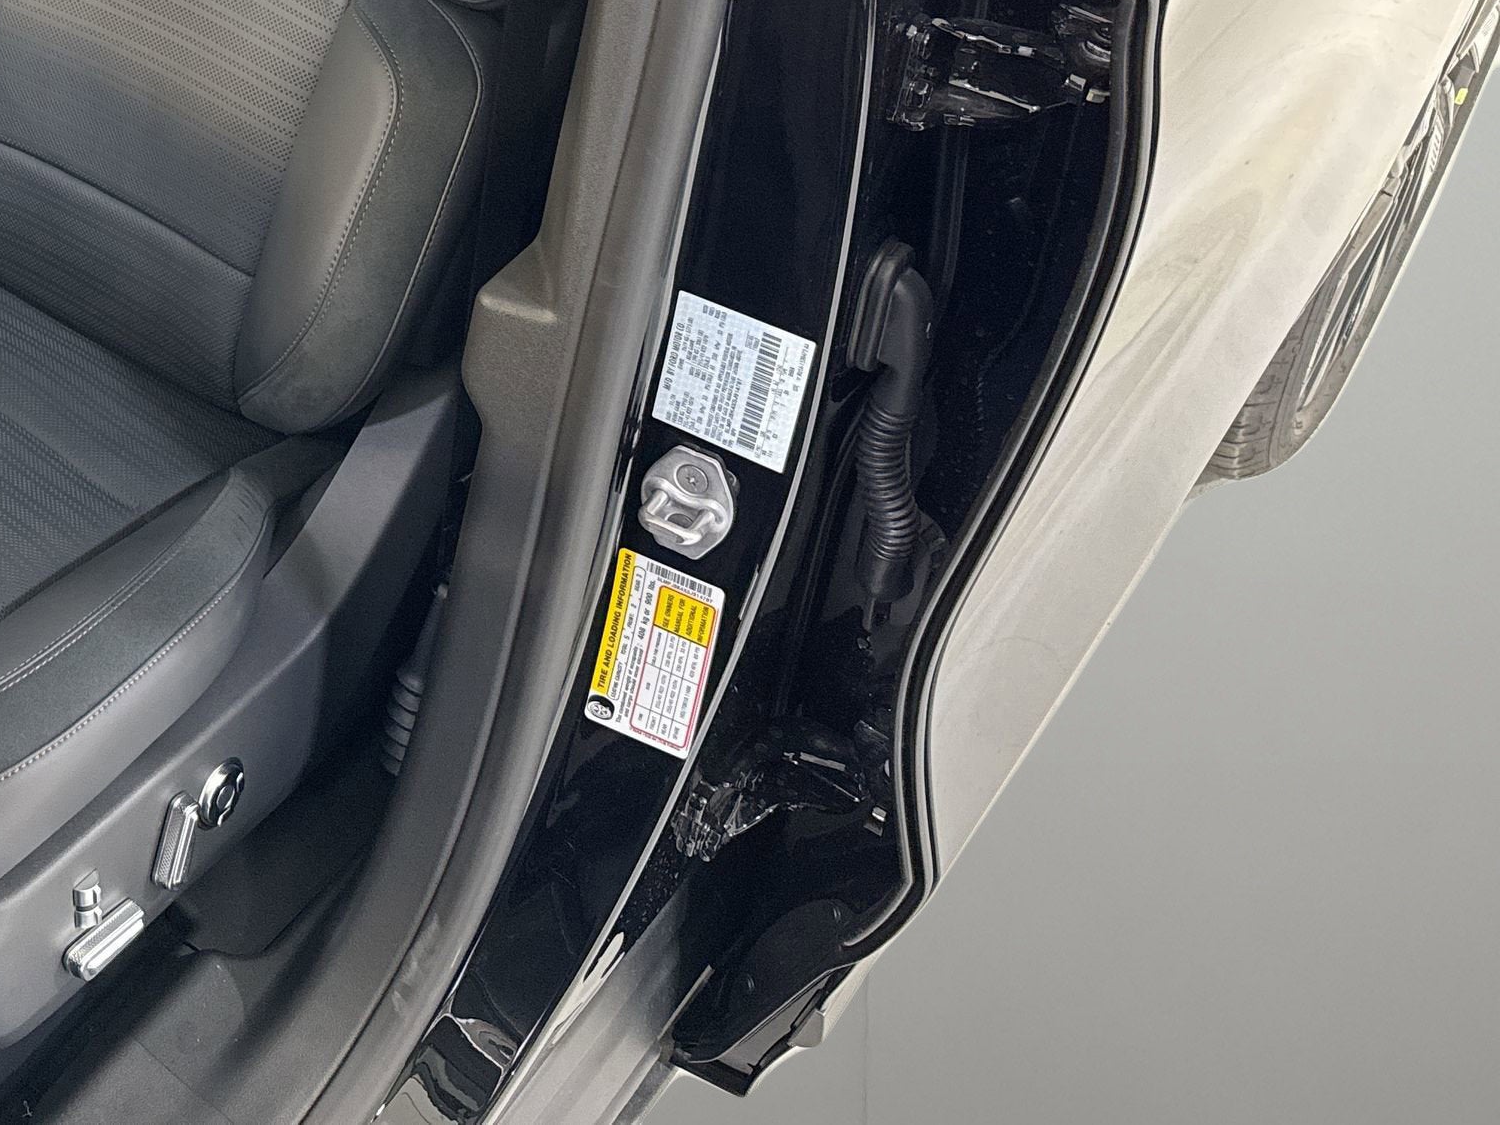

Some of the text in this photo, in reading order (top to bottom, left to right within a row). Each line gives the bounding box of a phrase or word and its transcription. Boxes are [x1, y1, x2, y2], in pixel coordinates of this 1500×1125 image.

[671, 331, 682, 351] MOTOR
[668, 350, 677, 367] FORD
[644, 591, 652, 605] 900
[597, 552, 633, 689] TIRE AND LOADING INFORMATION
